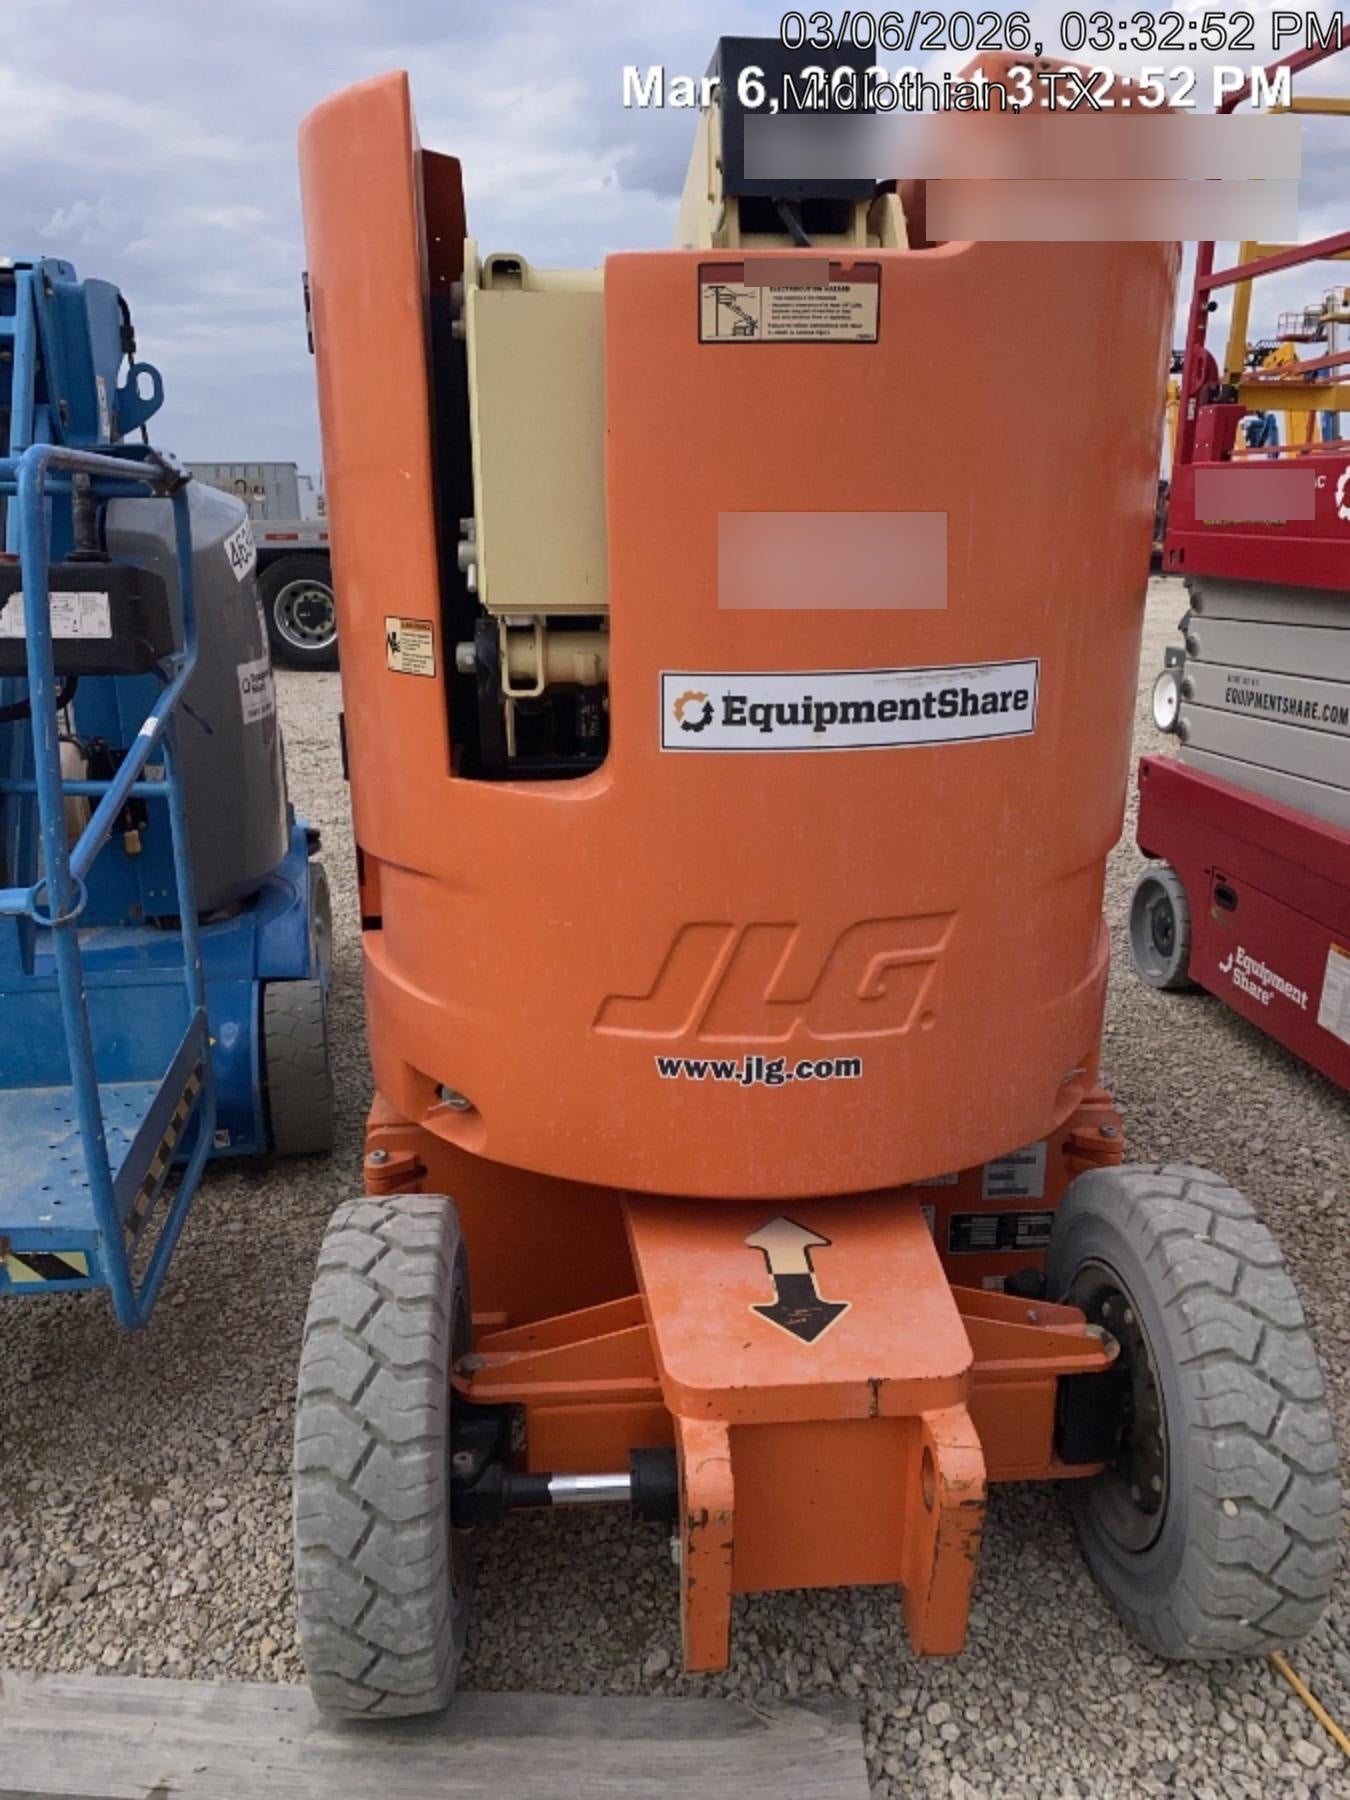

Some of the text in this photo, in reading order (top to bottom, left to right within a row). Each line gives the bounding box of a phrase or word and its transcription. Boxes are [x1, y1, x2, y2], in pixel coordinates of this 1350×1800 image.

[721, 687, 1029, 732] EquipmentShare
[1225, 687, 1349, 725] EQUIPMENTSHARE.COM
[591, 909, 960, 1043] JLG
[1232, 967, 1270, 1006] Share
[1235, 945, 1309, 1011] Equipment
[655, 1055, 863, 1086] www.jlg.com
